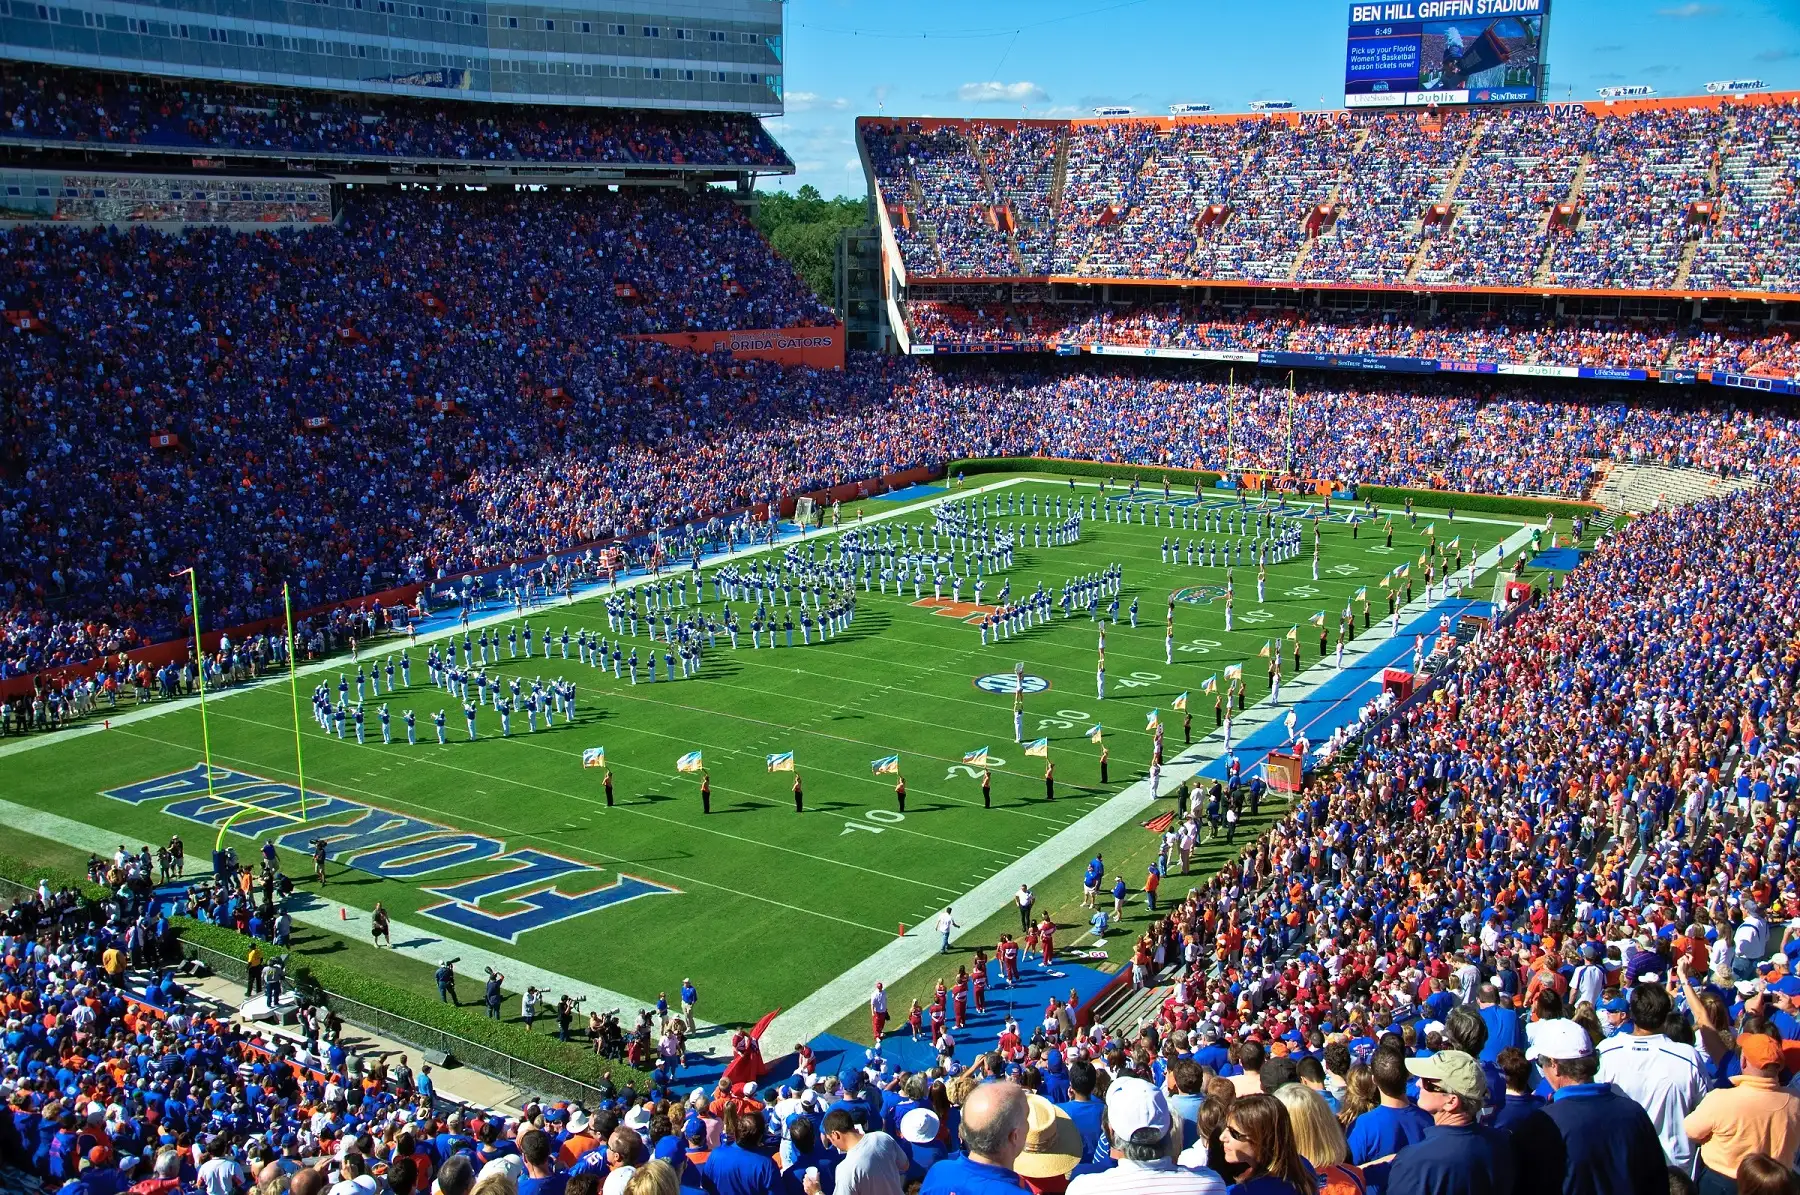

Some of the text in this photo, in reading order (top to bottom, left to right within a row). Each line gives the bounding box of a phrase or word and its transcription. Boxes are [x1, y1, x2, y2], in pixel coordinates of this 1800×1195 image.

[1353, 0, 1540, 22] BEN HILL GRIFFIN STADIUM
[1375, 27, 1392, 36] 6:49
[1351, 47, 1366, 55] Pick
[1376, 47, 1392, 55] your
[1392, 44, 1416, 52] Florida
[1350, 53, 1416, 63] Women's Basketball
[1375, 62, 1397, 70] tickets
[1417, 93, 1455, 102] Publix
[1395, 109, 1418, 122] TO
[1509, 104, 1586, 120] SWAMP
[713, 336, 833, 352] FLORIDA GATORS
[1440, 362, 1478, 372] BE FREE
[1528, 367, 1562, 375] Publix
[1325, 562, 1360, 576] 20
[1283, 584, 1320, 598] 30
[1237, 608, 1275, 624] 40
[1177, 639, 1222, 654] 50
[1118, 671, 1162, 688] 40
[1040, 709, 1091, 730] 30
[948, 756, 1006, 779] 20
[845, 809, 906, 834] 10
